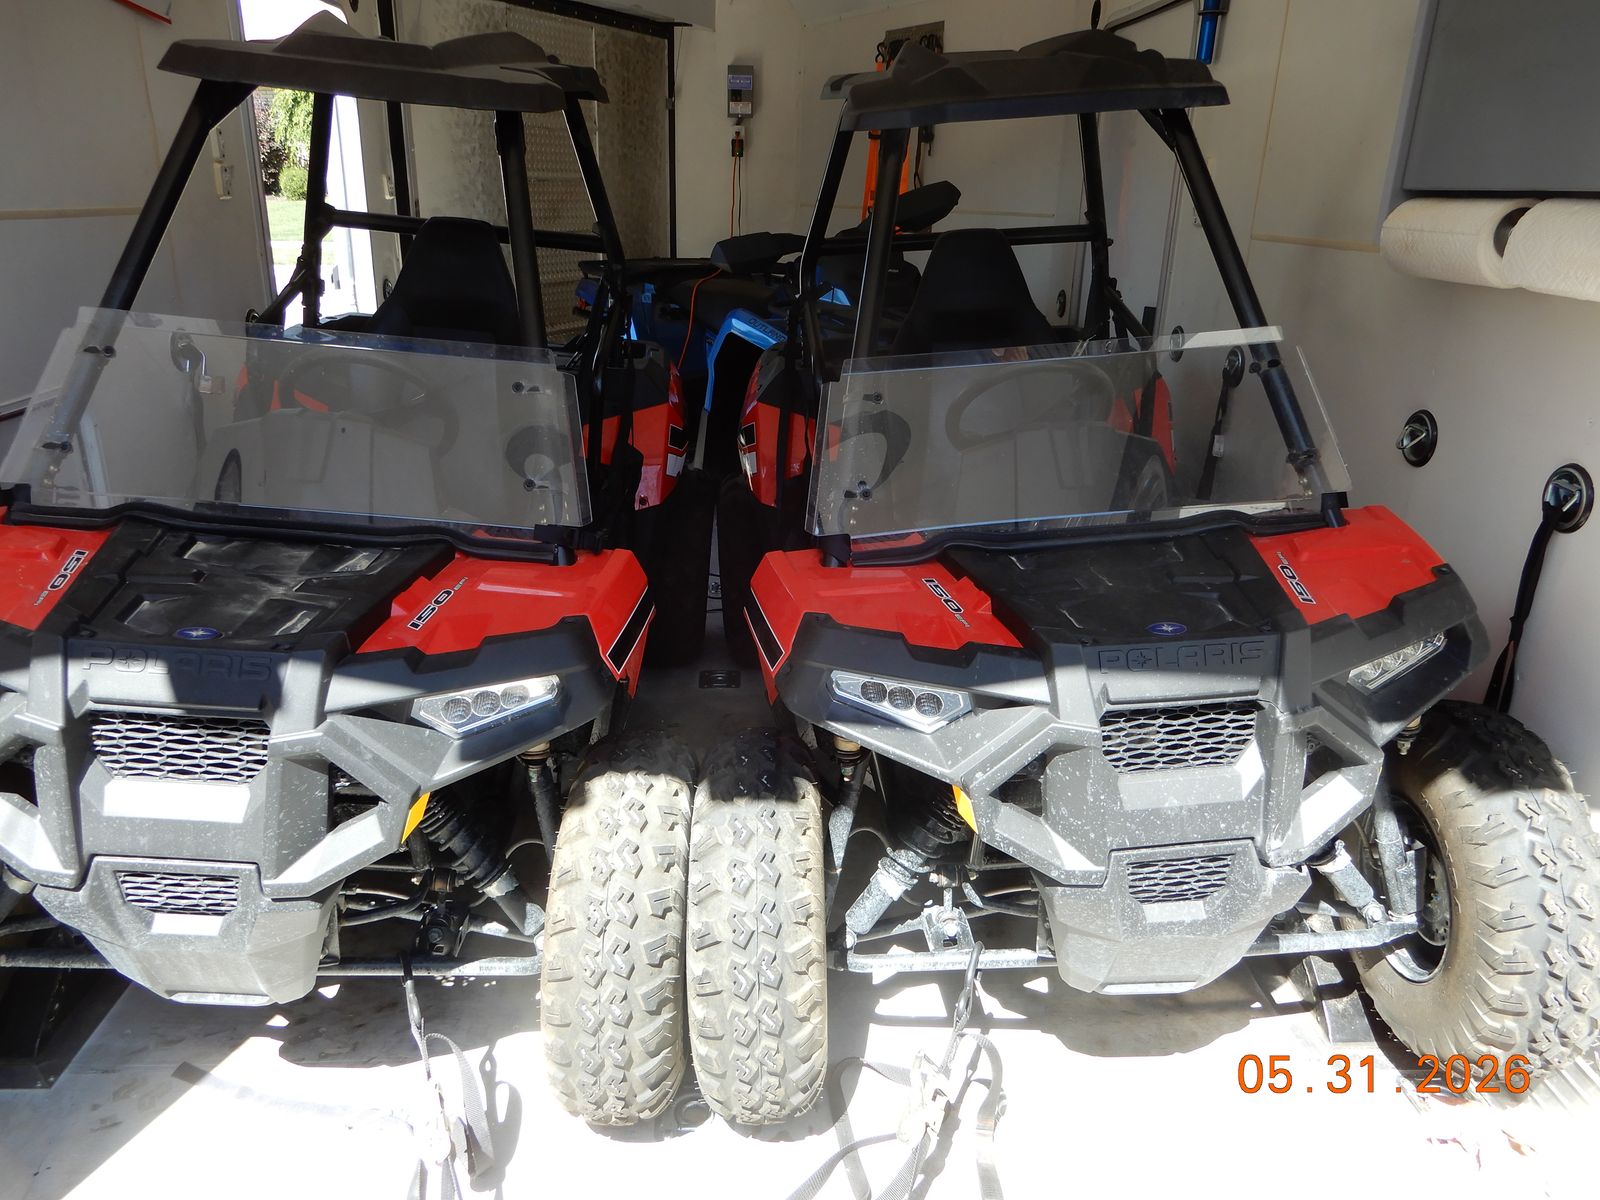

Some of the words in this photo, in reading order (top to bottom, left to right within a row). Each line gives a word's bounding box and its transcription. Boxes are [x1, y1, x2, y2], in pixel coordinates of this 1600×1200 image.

[47, 549, 89, 591] 150
[1277, 564, 1317, 605] 150
[407, 588, 455, 631] 150
[921, 577, 964, 614] 150
[82, 647, 272, 681] POLARIS
[1097, 640, 1265, 674] POLARIS
